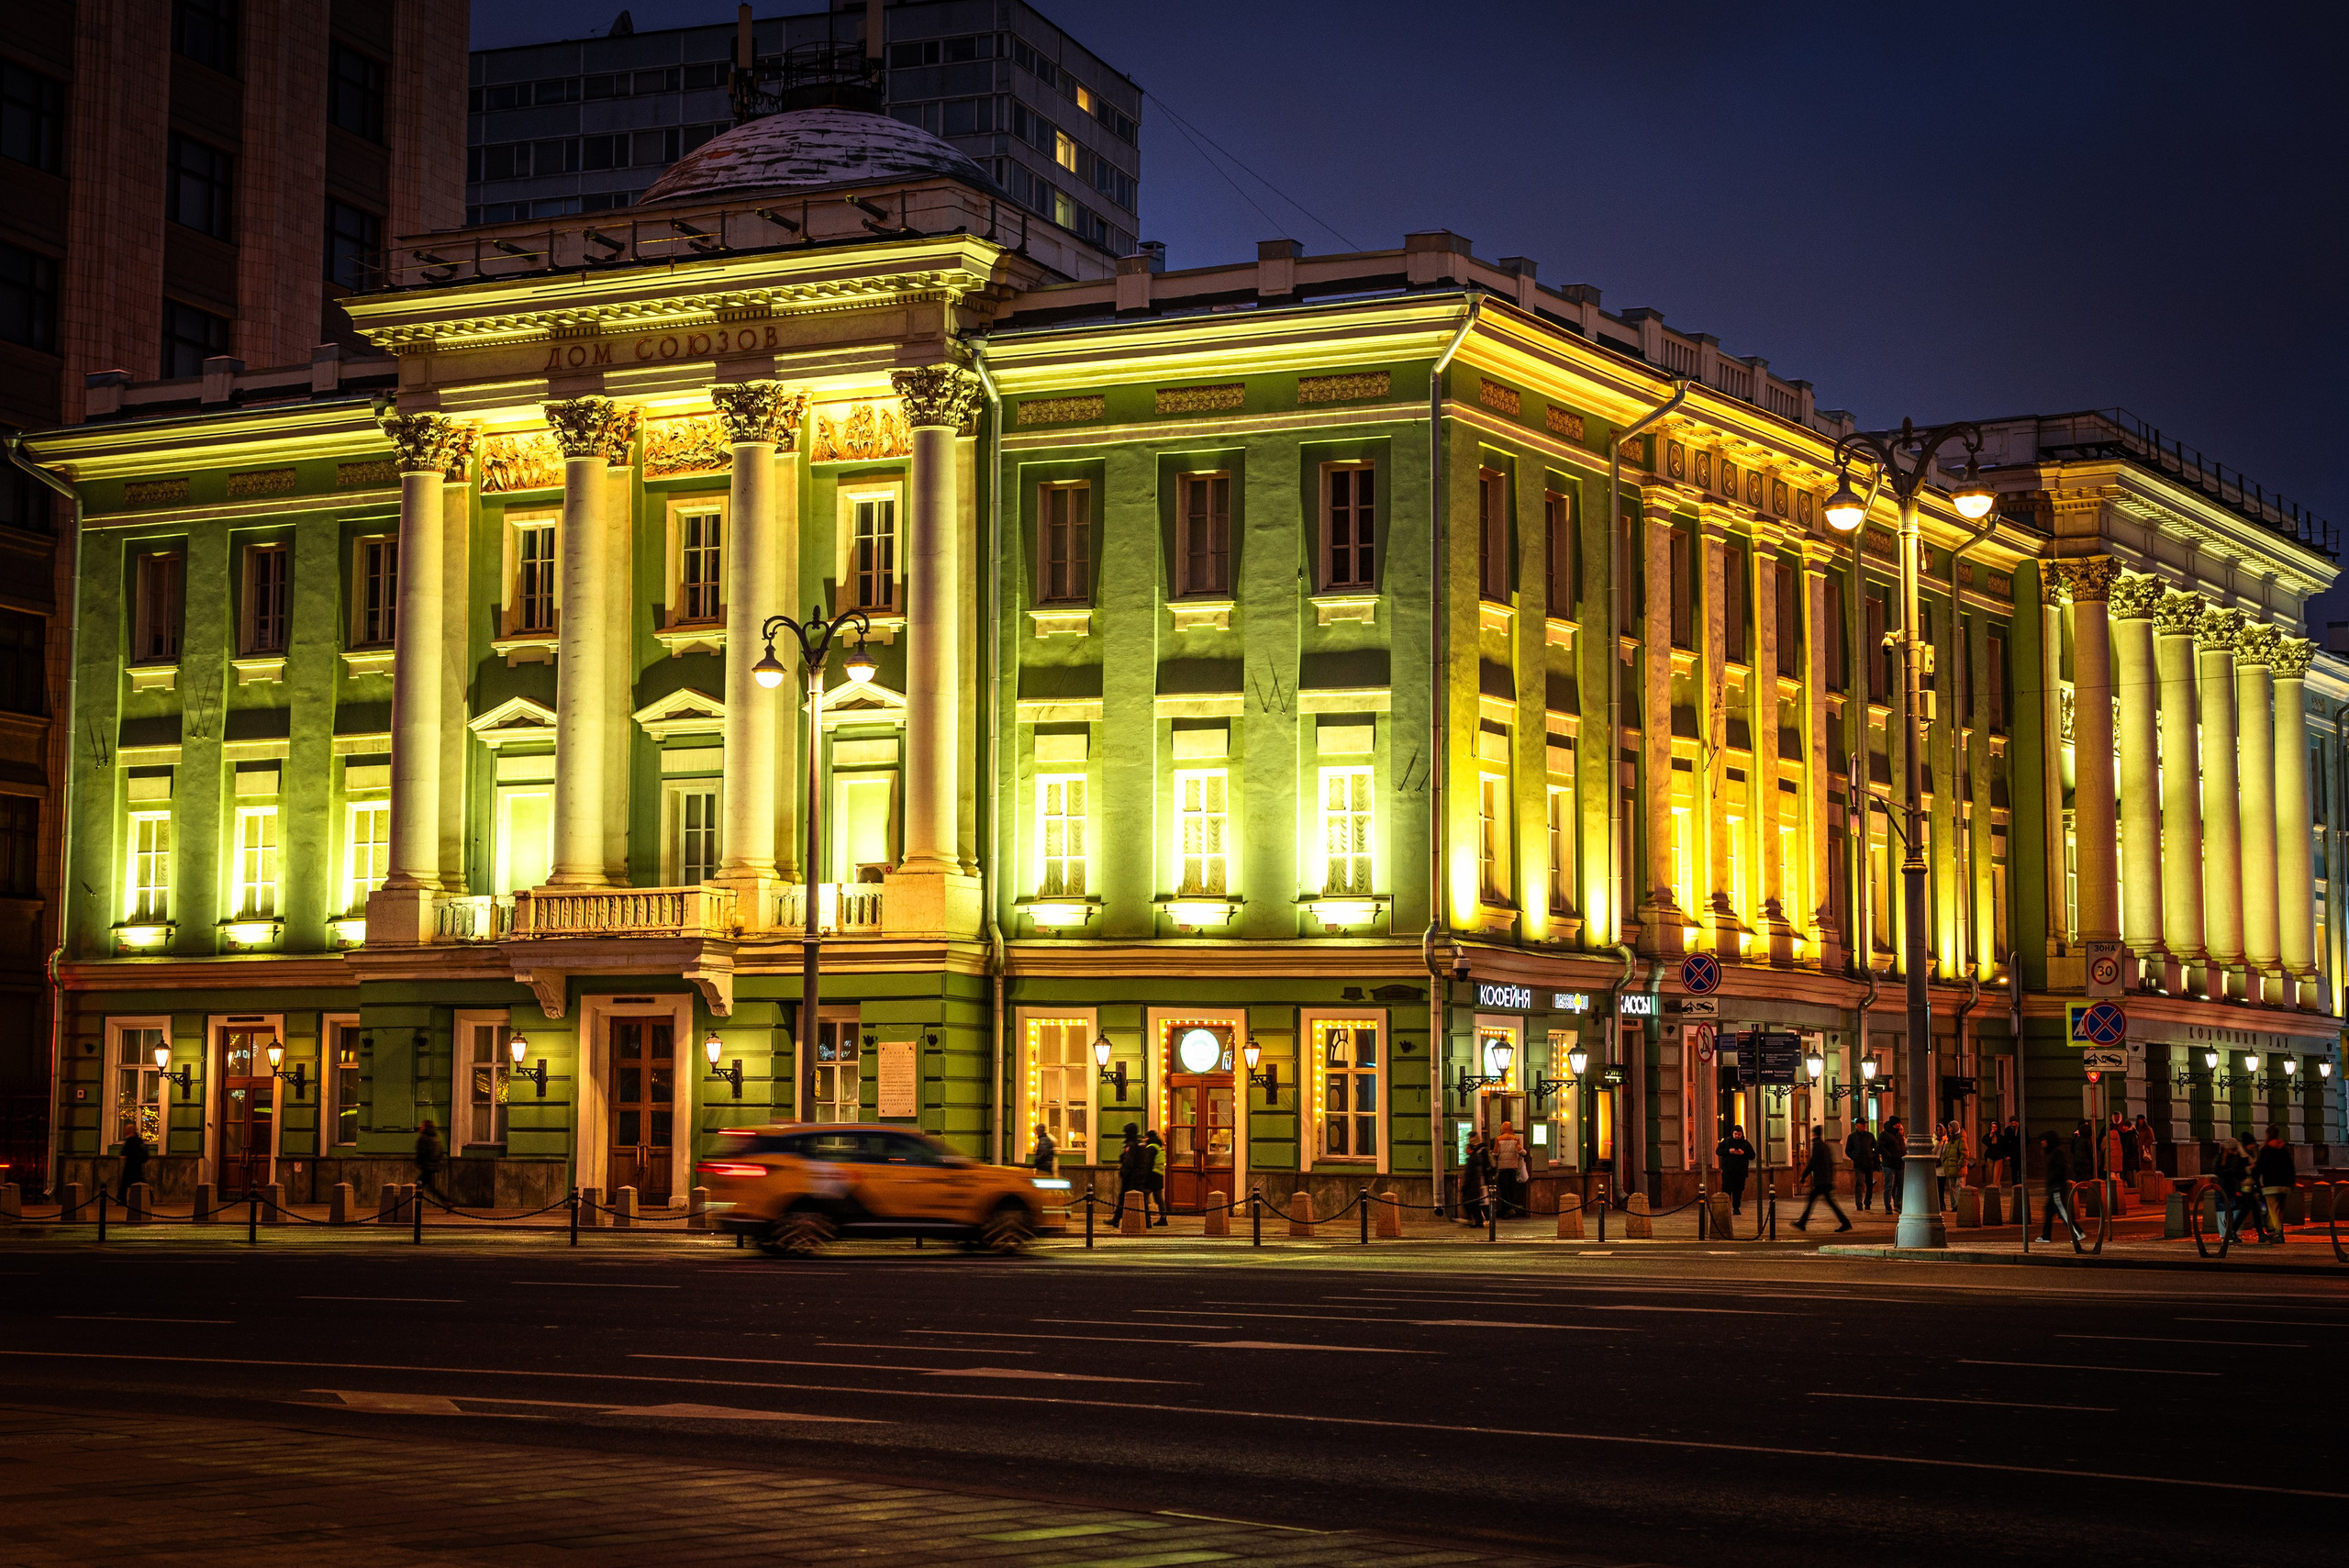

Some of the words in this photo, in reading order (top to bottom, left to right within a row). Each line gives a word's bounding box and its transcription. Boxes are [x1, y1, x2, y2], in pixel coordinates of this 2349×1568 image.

[544, 341, 613, 372] ДОМ
[635, 326, 778, 361] СОЮЗОВ
[2097, 965, 2113, 977] 30
[1479, 984, 1531, 1009] КОФЕЙНЯ
